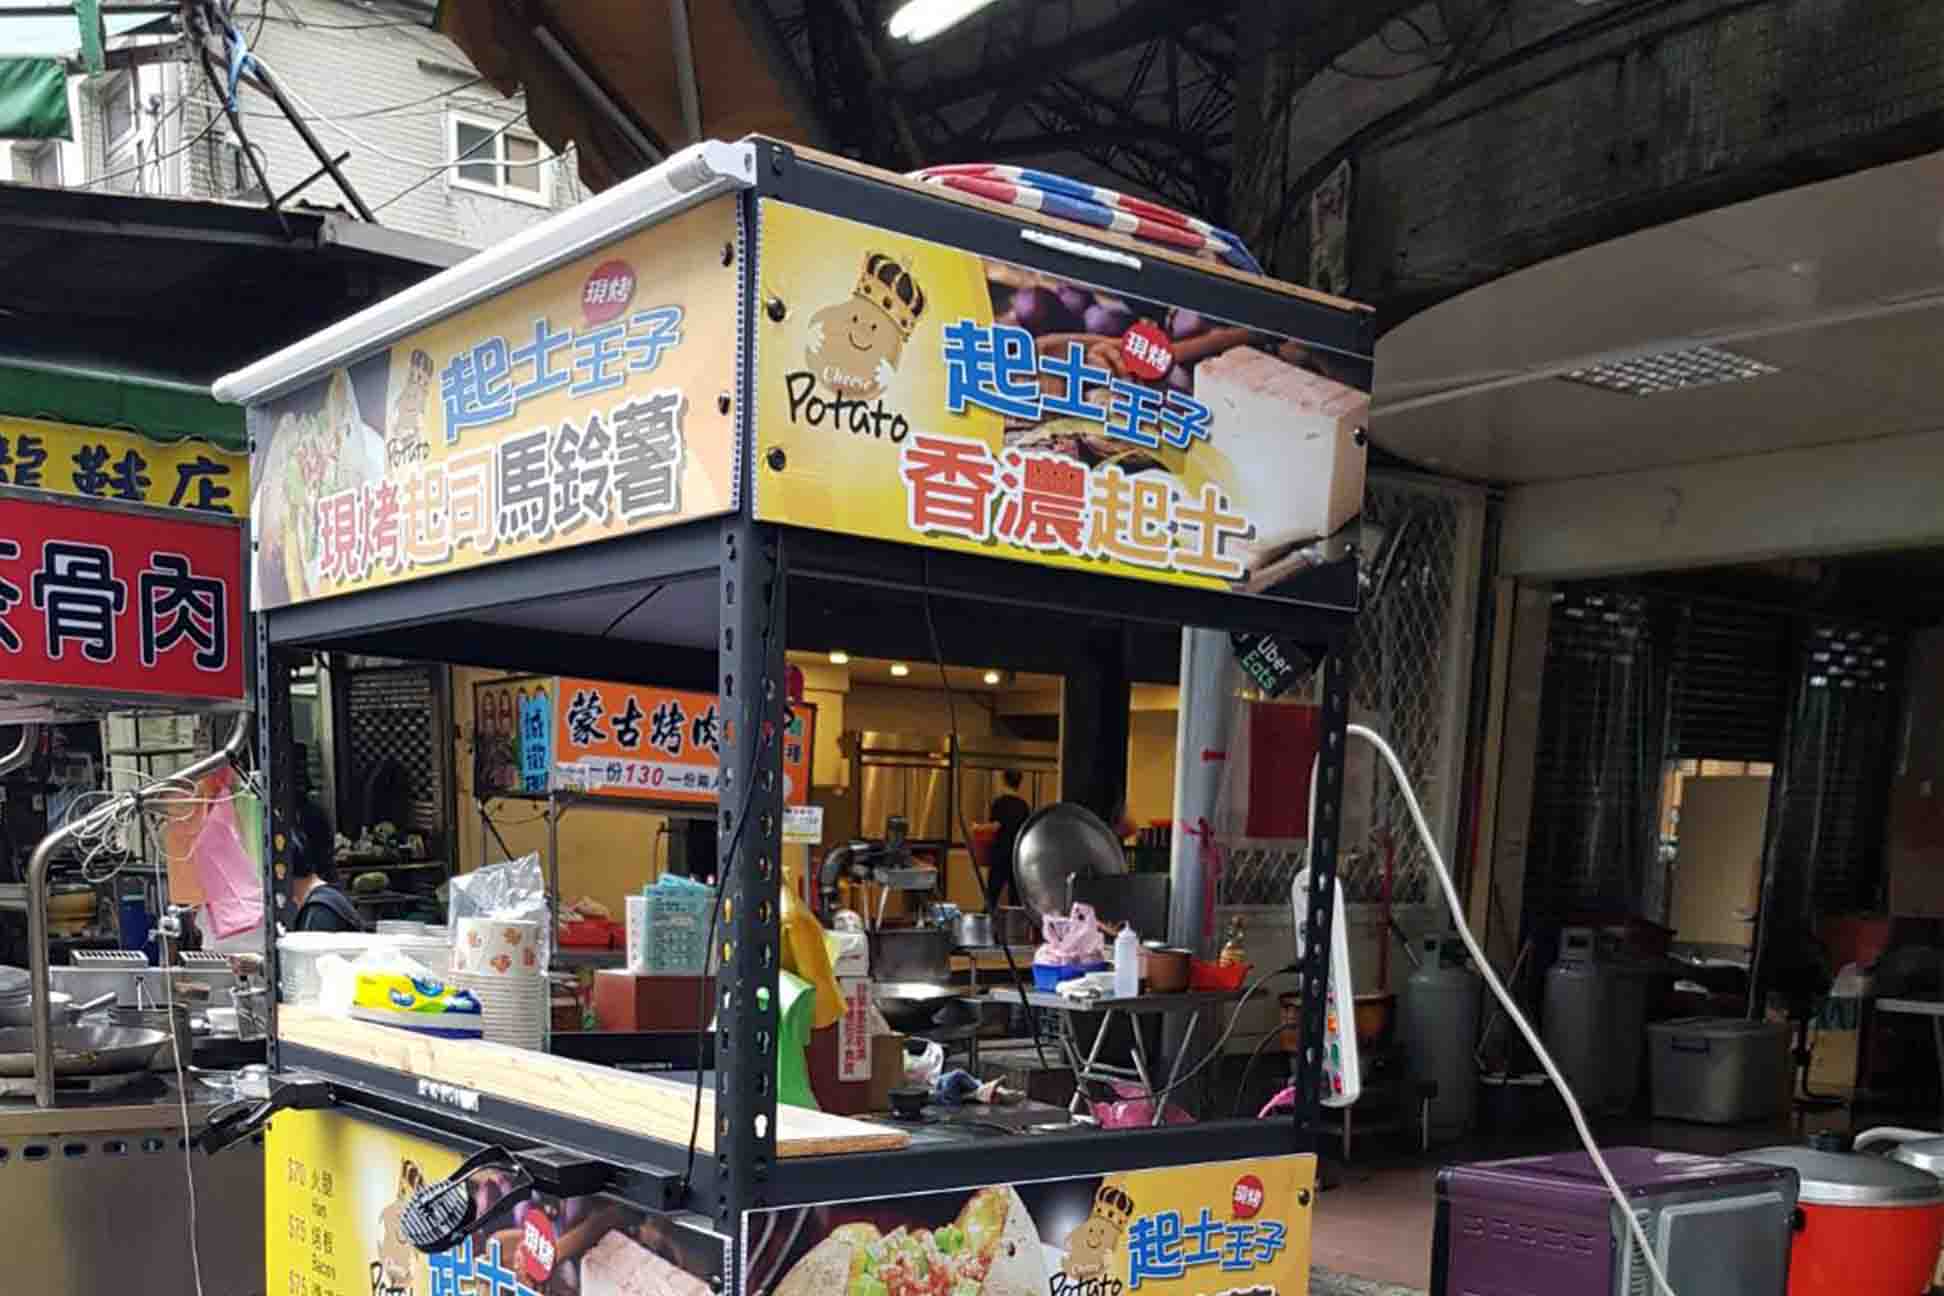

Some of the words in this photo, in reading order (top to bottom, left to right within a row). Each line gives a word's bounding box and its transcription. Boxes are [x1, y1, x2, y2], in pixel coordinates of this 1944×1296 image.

[1125, 331, 1173, 372] 現烤
[785, 371, 908, 443] Potato
[318, 392, 684, 582] 現烤起司馬鈴薯
[1241, 650, 1277, 689] Eats
[1257, 633, 1293, 676] Uber
